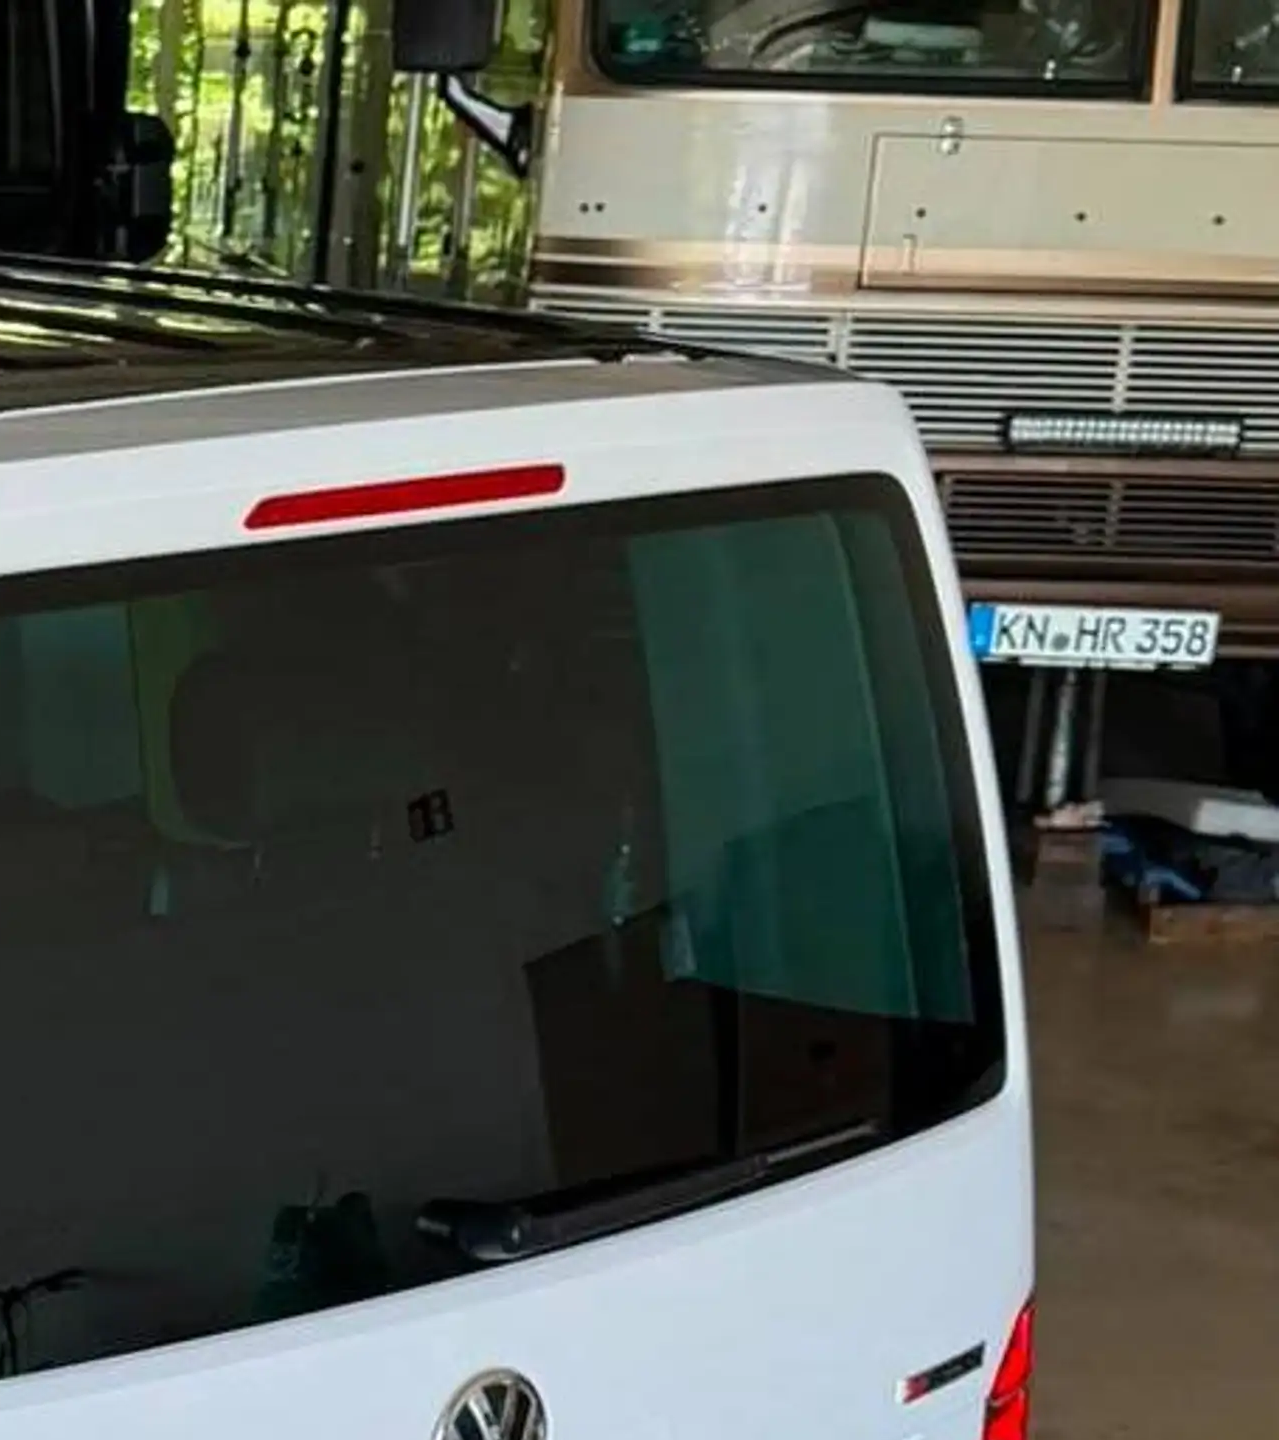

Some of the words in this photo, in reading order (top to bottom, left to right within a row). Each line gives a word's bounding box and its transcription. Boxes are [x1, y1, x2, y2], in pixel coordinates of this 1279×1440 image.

[995, 614, 1050, 652] KN
[1073, 615, 1126, 654] HR
[1135, 617, 1211, 657] 358
